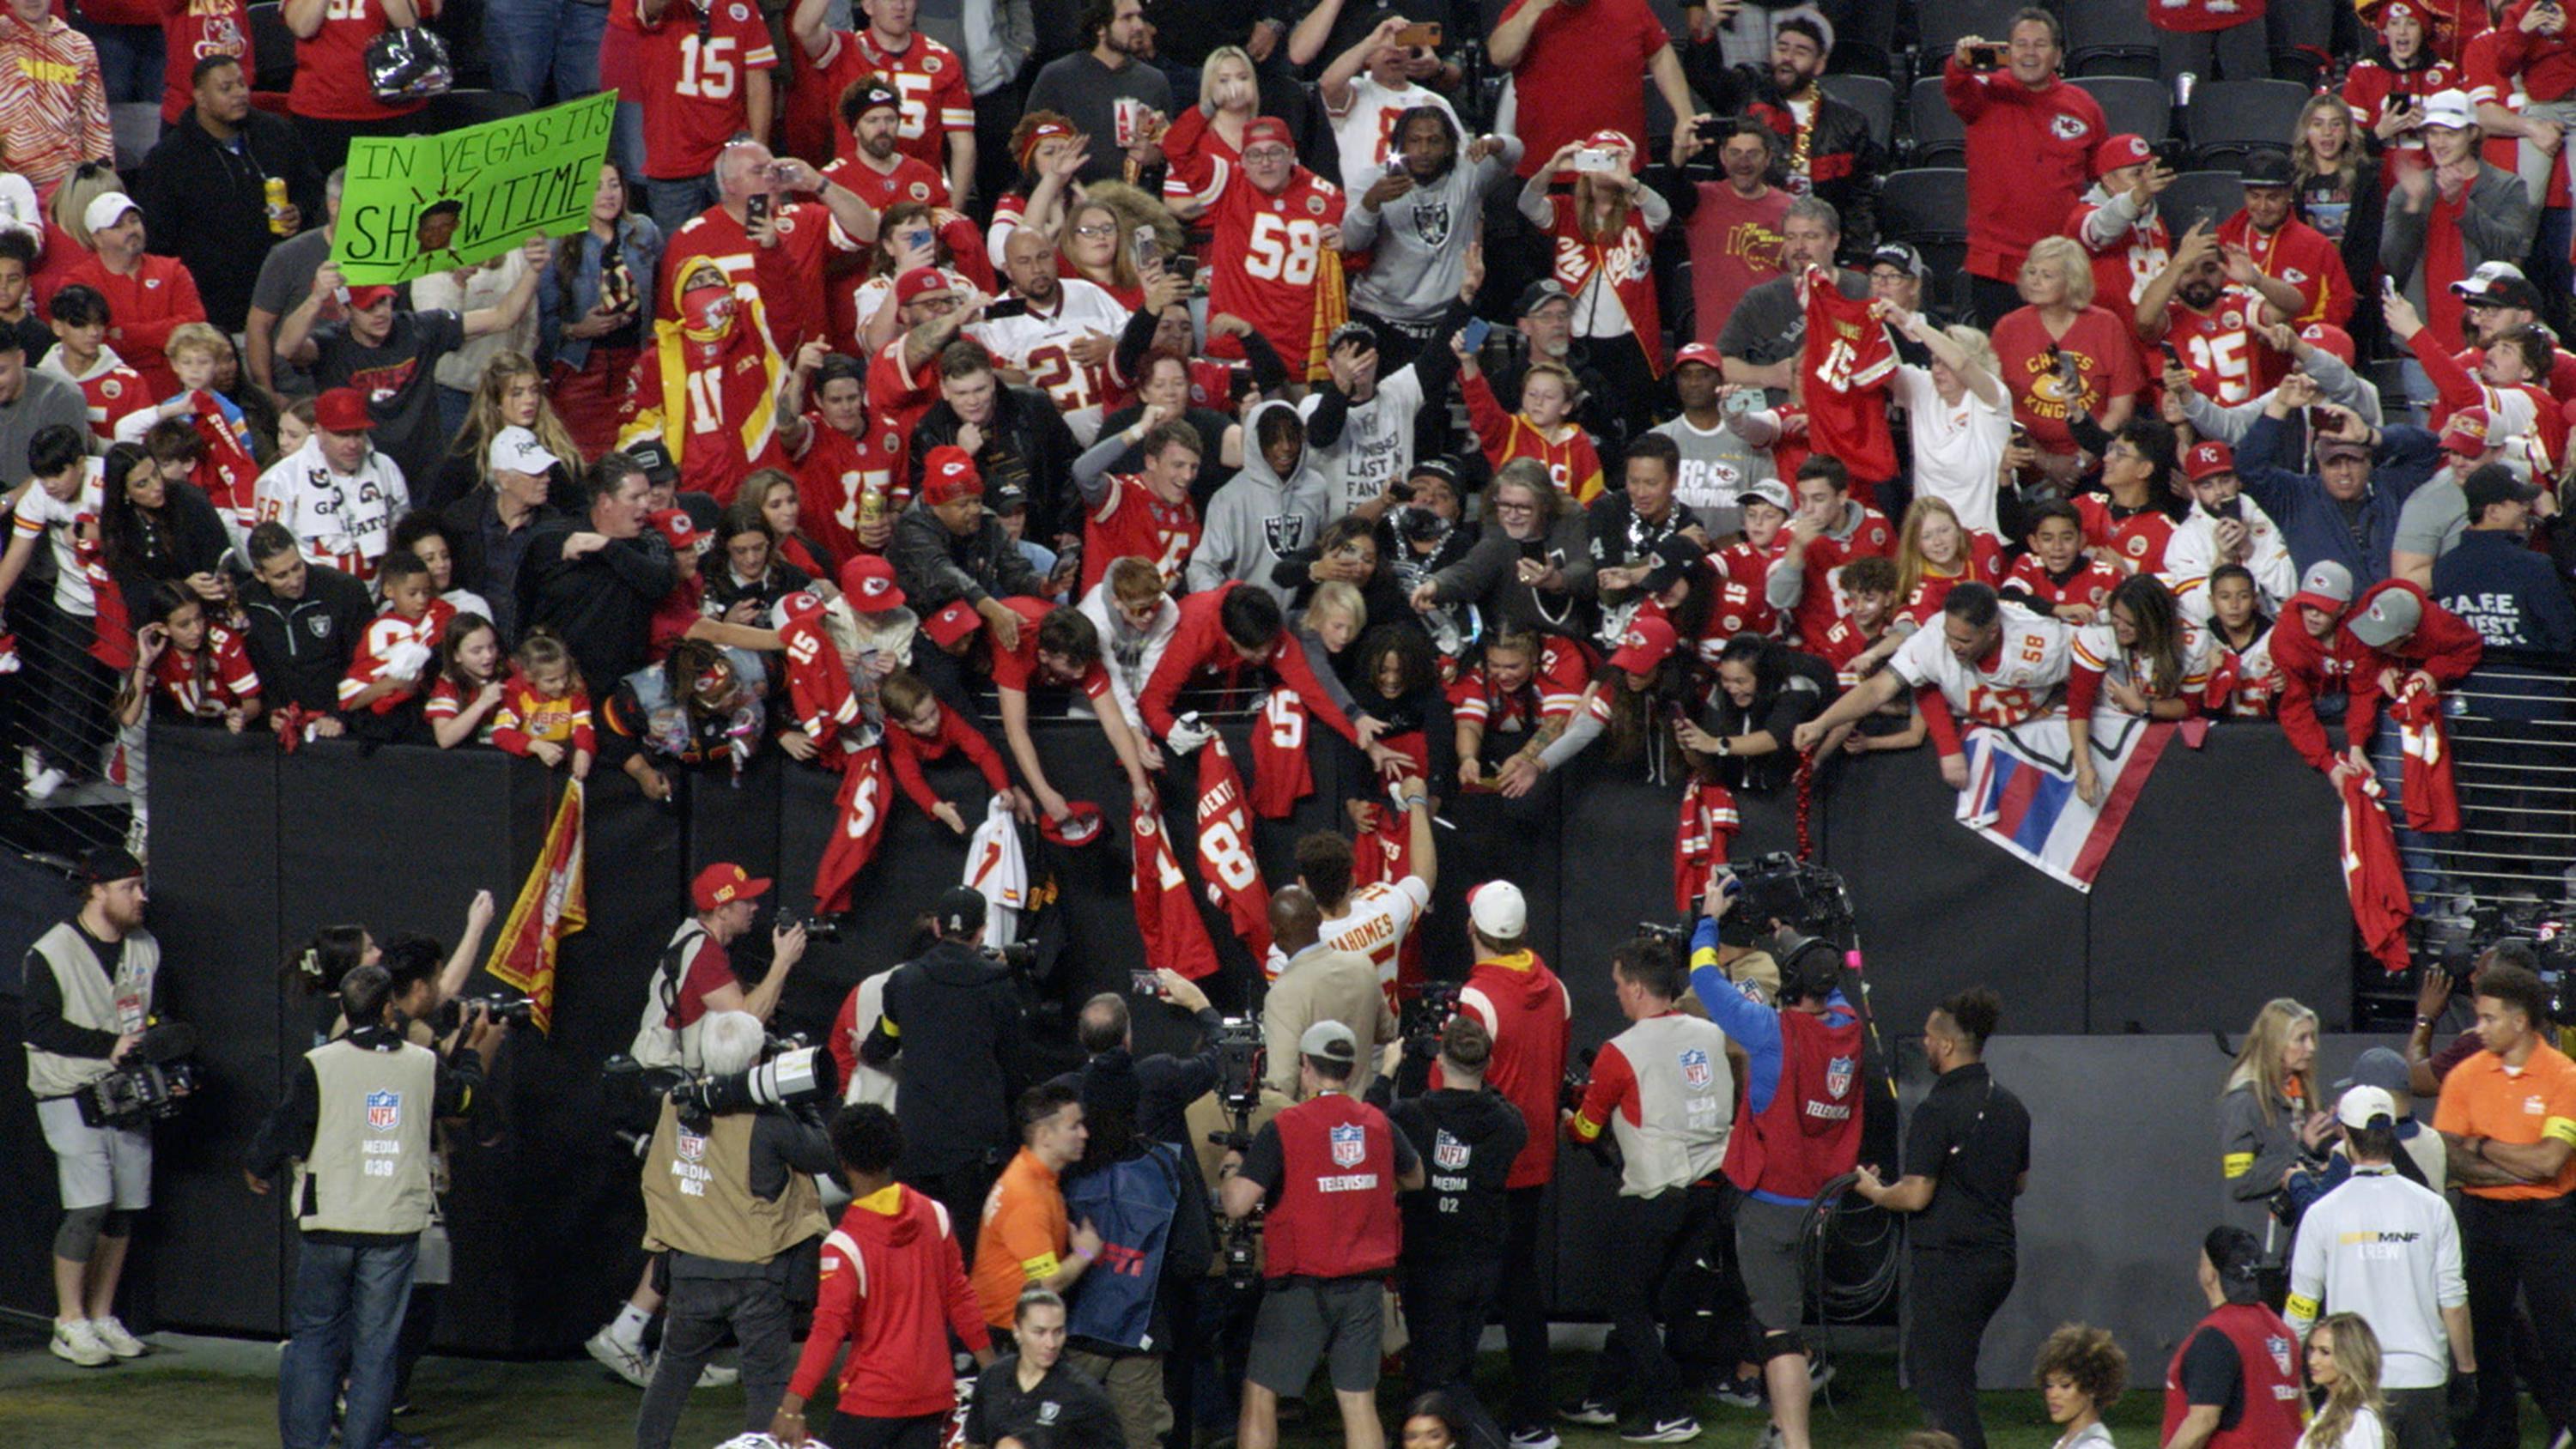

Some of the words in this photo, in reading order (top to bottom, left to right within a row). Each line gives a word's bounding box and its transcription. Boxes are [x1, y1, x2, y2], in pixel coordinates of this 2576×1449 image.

[676, 33, 735, 98] 15
[354, 144, 417, 181] IN
[438, 117, 551, 175] VEGAS
[1243, 210, 1318, 286] 58
[2189, 330, 2250, 403] 15
[2198, 446, 2219, 463] KC
[1346, 458, 1388, 478] LAST
[787, 630, 820, 665] 15
[2022, 634, 2044, 664] 58
[1686, 1064, 1709, 1082] NFL
[371, 1106, 396, 1126] NFL
[361, 1139, 401, 1155] MEDIA
[680, 1137, 702, 1157] NFL
[1334, 1143, 1362, 1162] NFL
[1439, 1143, 1466, 1164] NFL
[364, 1159, 394, 1176] 039
[671, 1160, 713, 1182] MEDIA
[1316, 1173, 1378, 1193] TELEVISION
[1431, 1174, 1468, 1191] MEDIA
[1438, 1197, 1459, 1213] 02
[2378, 1233, 2421, 1243] MNF
